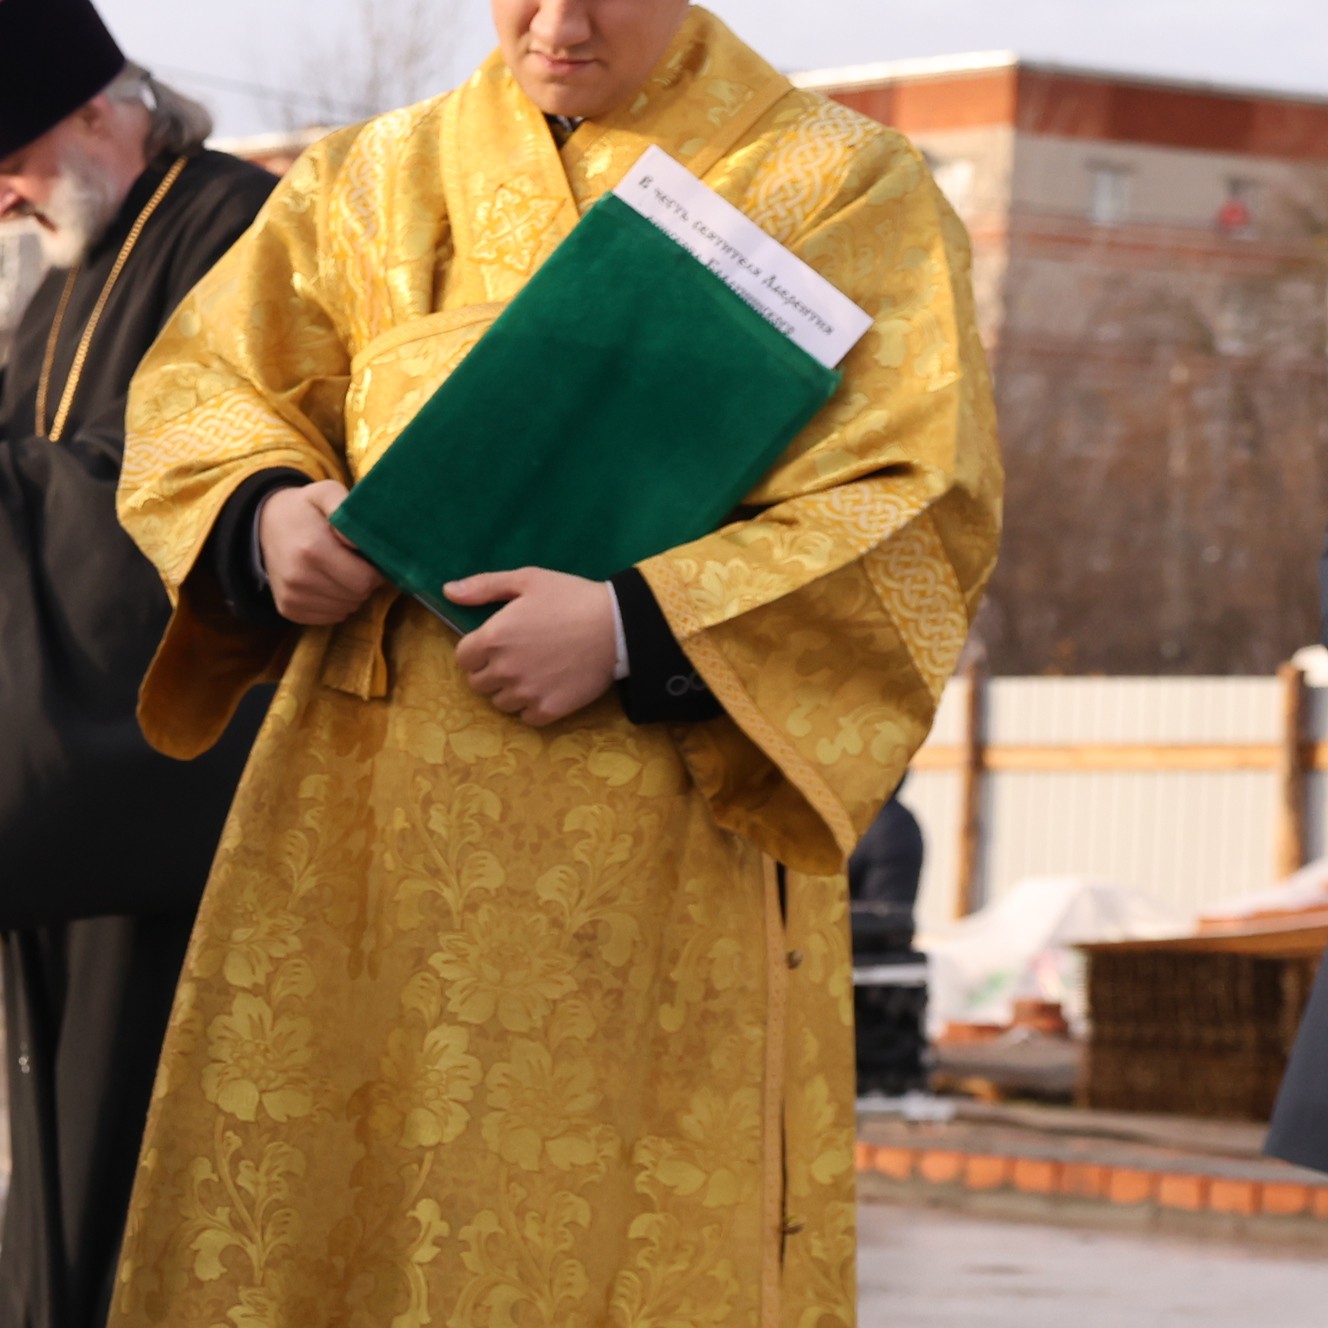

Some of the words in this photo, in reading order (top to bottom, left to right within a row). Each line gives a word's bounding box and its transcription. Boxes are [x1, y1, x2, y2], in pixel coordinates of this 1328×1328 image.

[638, 175, 652, 190] В
[654, 187, 690, 222] честь
[762, 273, 836, 337] Лаврентия
